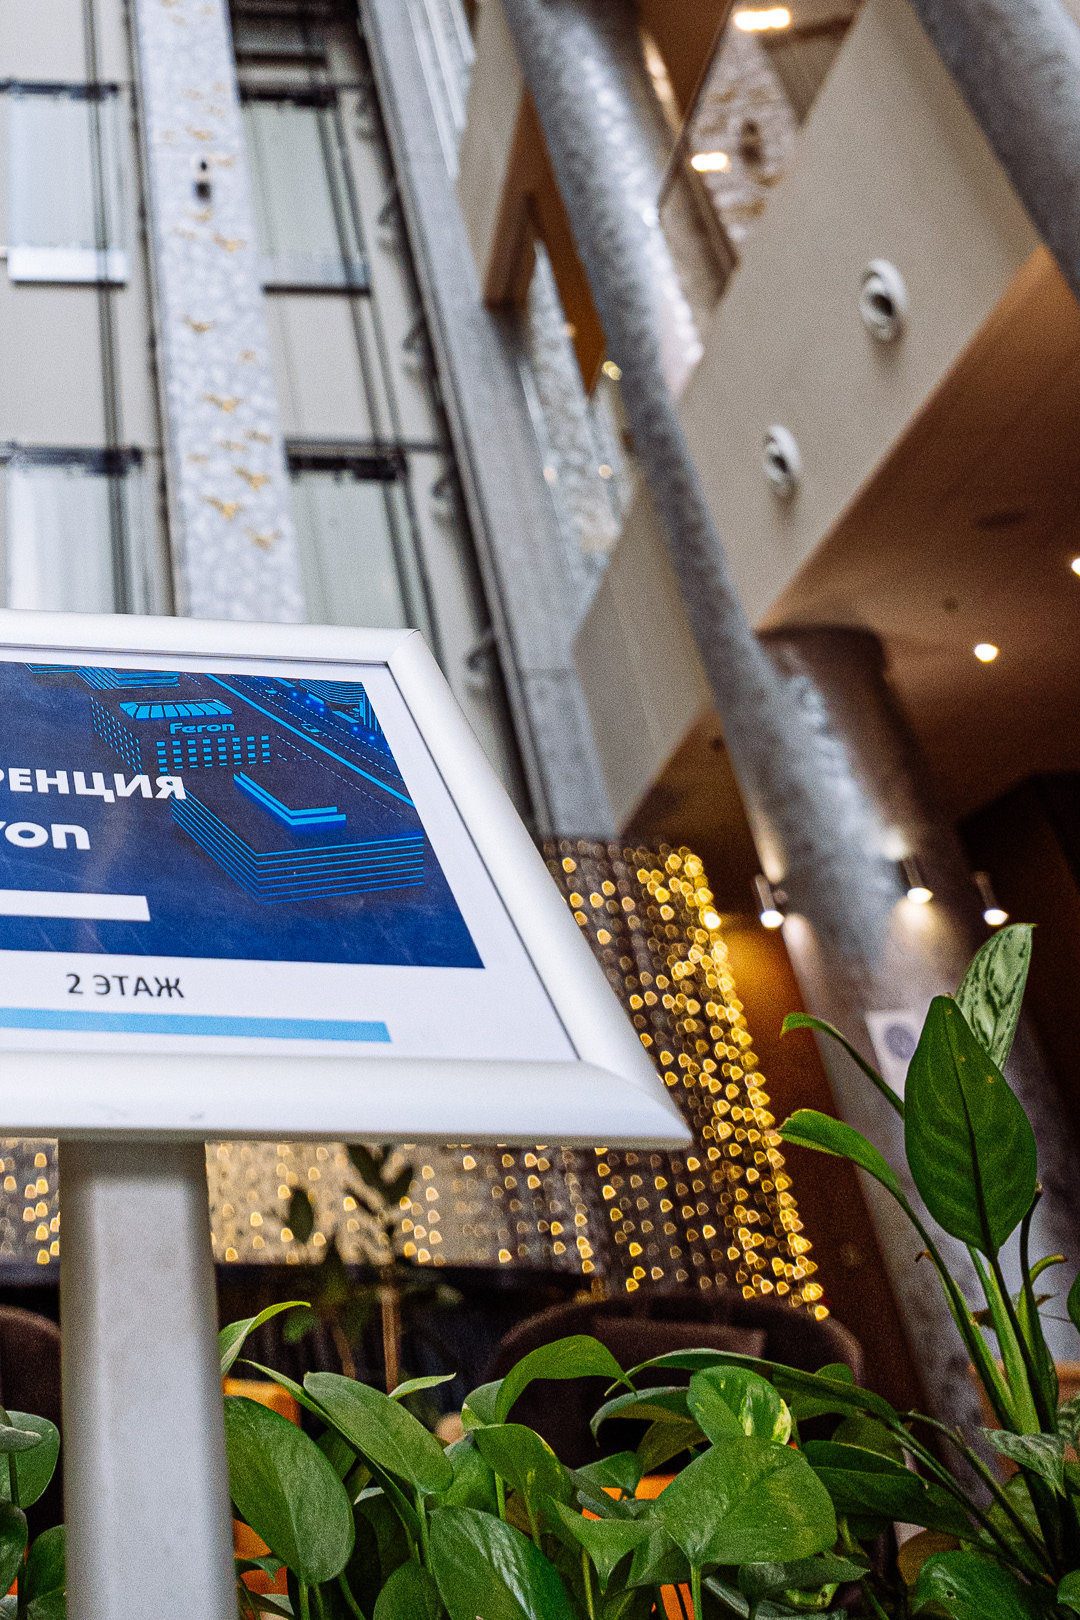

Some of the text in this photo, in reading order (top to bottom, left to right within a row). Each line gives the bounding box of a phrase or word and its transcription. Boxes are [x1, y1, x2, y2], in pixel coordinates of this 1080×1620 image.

[169, 721, 236, 735] Feron
[66, 973, 186, 1000] 2 ЭТАЖ
